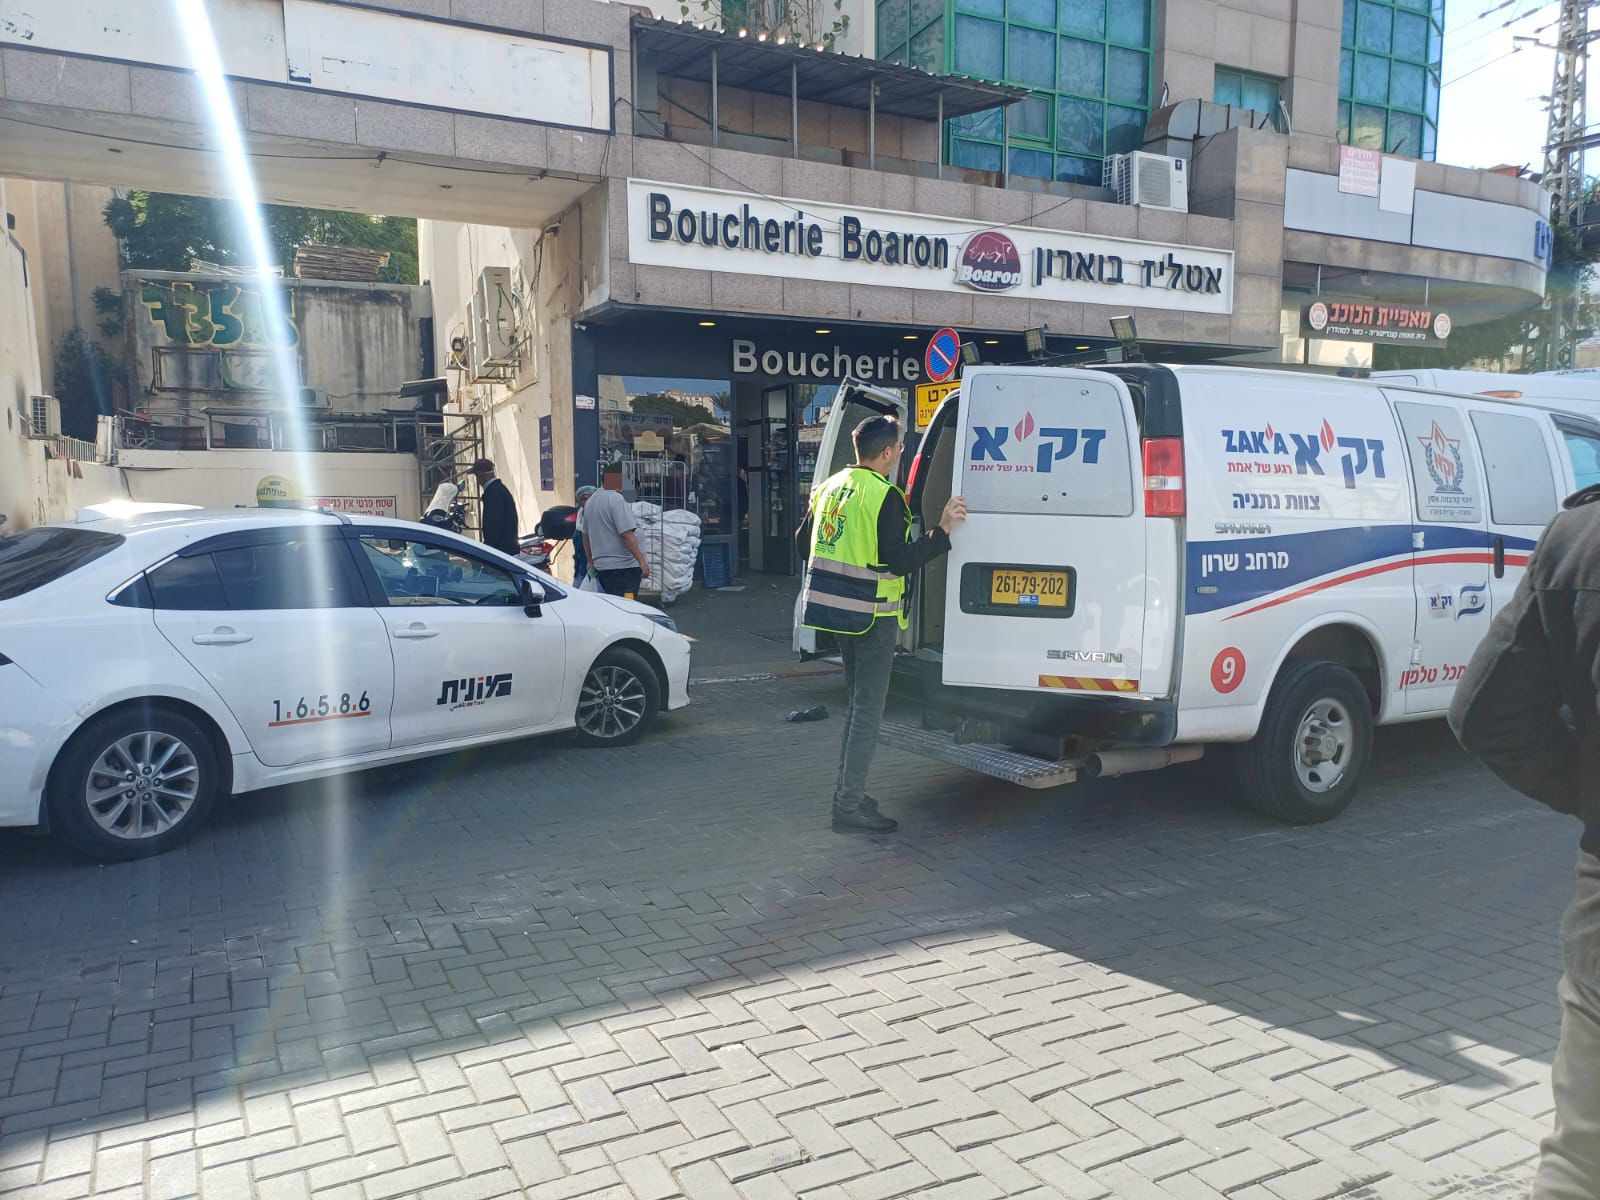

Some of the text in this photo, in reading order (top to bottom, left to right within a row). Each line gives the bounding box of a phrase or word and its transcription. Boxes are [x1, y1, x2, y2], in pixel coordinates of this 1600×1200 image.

[648, 192, 948, 268] Boucherie Boaron
[956, 265, 1022, 285] Boaron
[1032, 246, 1223, 295] אטליז בוארון
[1330, 303, 1431, 329] מאפיית הכוכב
[732, 339, 919, 381] Boucherie
[969, 462, 1034, 473] רגע של אמת
[1227, 461, 1293, 475] רגע של אמת
[343, 498, 354, 510] אין
[355, 498, 374, 508] פרטי
[376, 498, 393, 508] שטח
[1232, 493, 1321, 510] צוות נתניה
[1201, 551, 1290, 578] מרחב שרון
[1222, 656, 1236, 685] 9
[1399, 666, 1438, 690] טלפון
[436, 673, 512, 706] מונית
